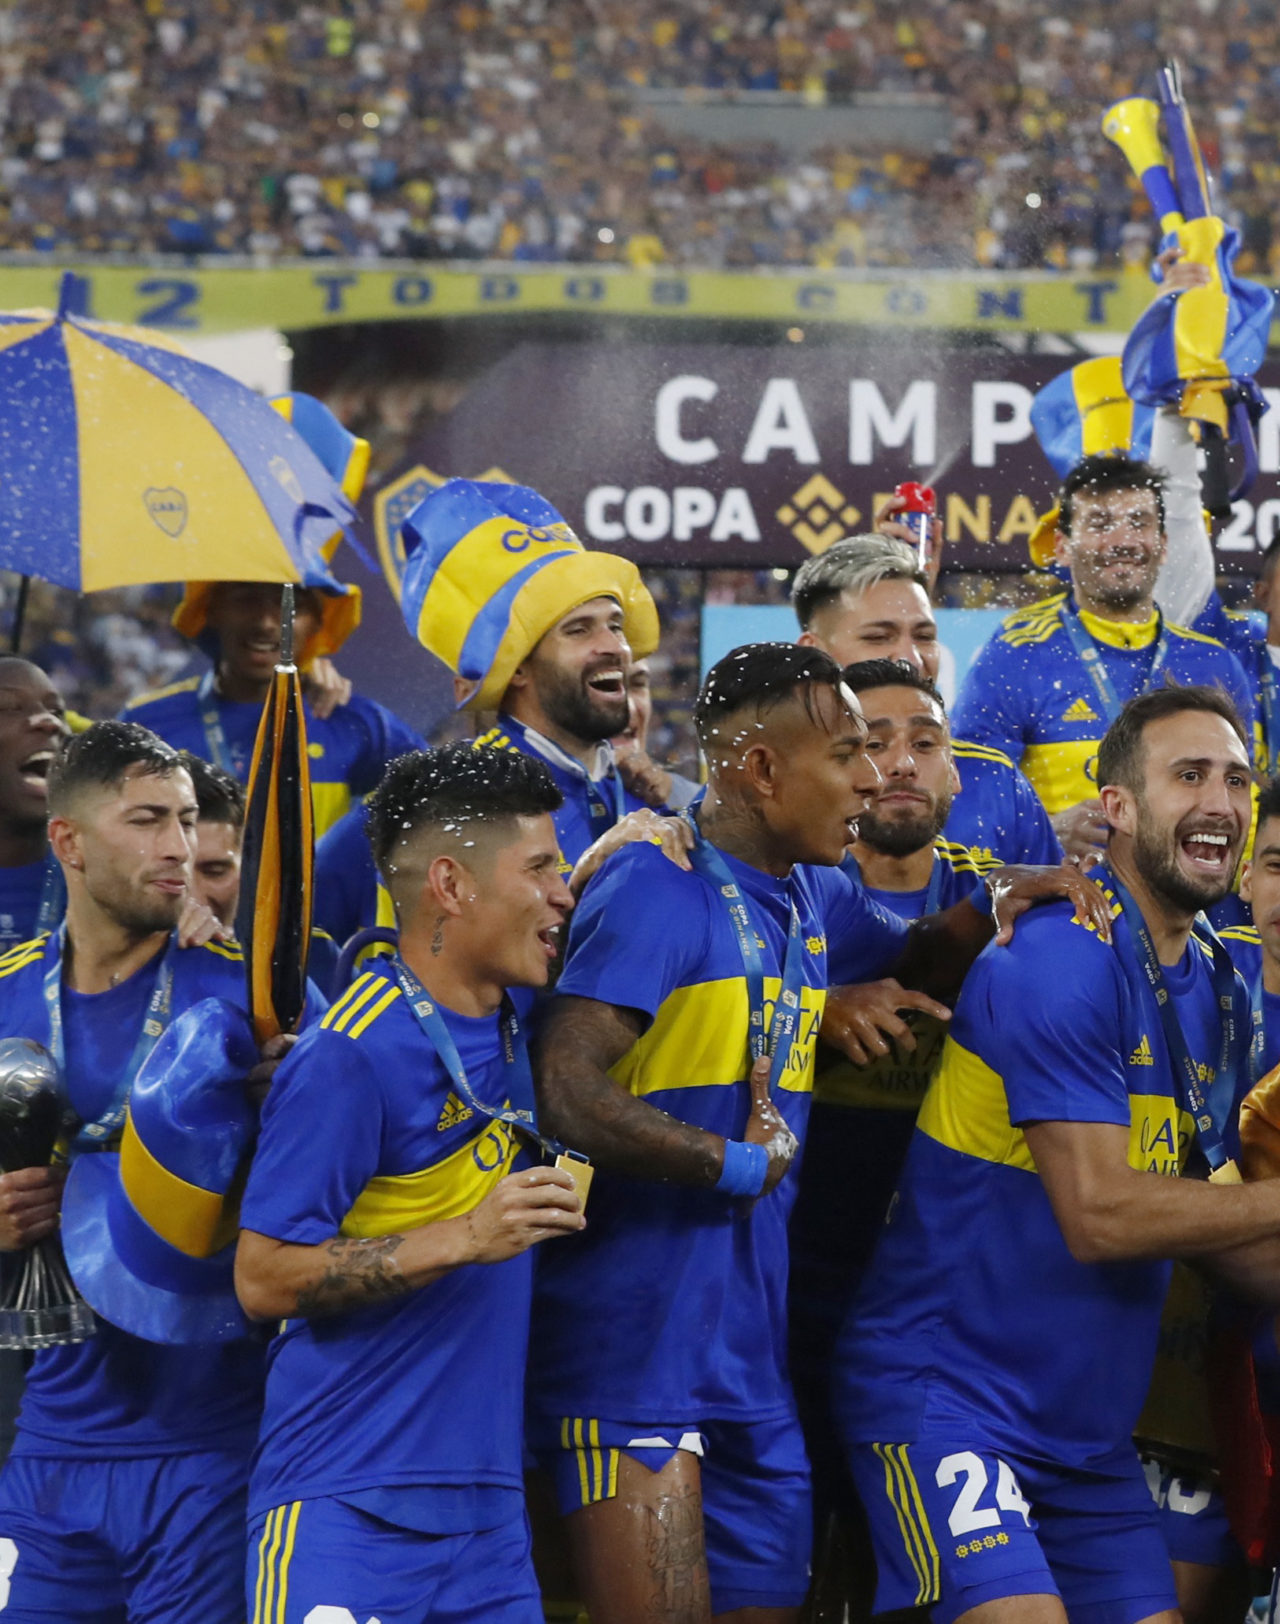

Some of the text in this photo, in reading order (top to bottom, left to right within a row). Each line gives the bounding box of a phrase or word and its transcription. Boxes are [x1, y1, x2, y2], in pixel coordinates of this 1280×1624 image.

[314, 273, 690, 313] TODOS
[584, 485, 762, 542] COPA
[736, 904, 749, 926] COPA
[783, 1015, 795, 1035] COPA
[1187, 1089, 1198, 1111] COPA
[935, 1450, 1031, 1538] 24
